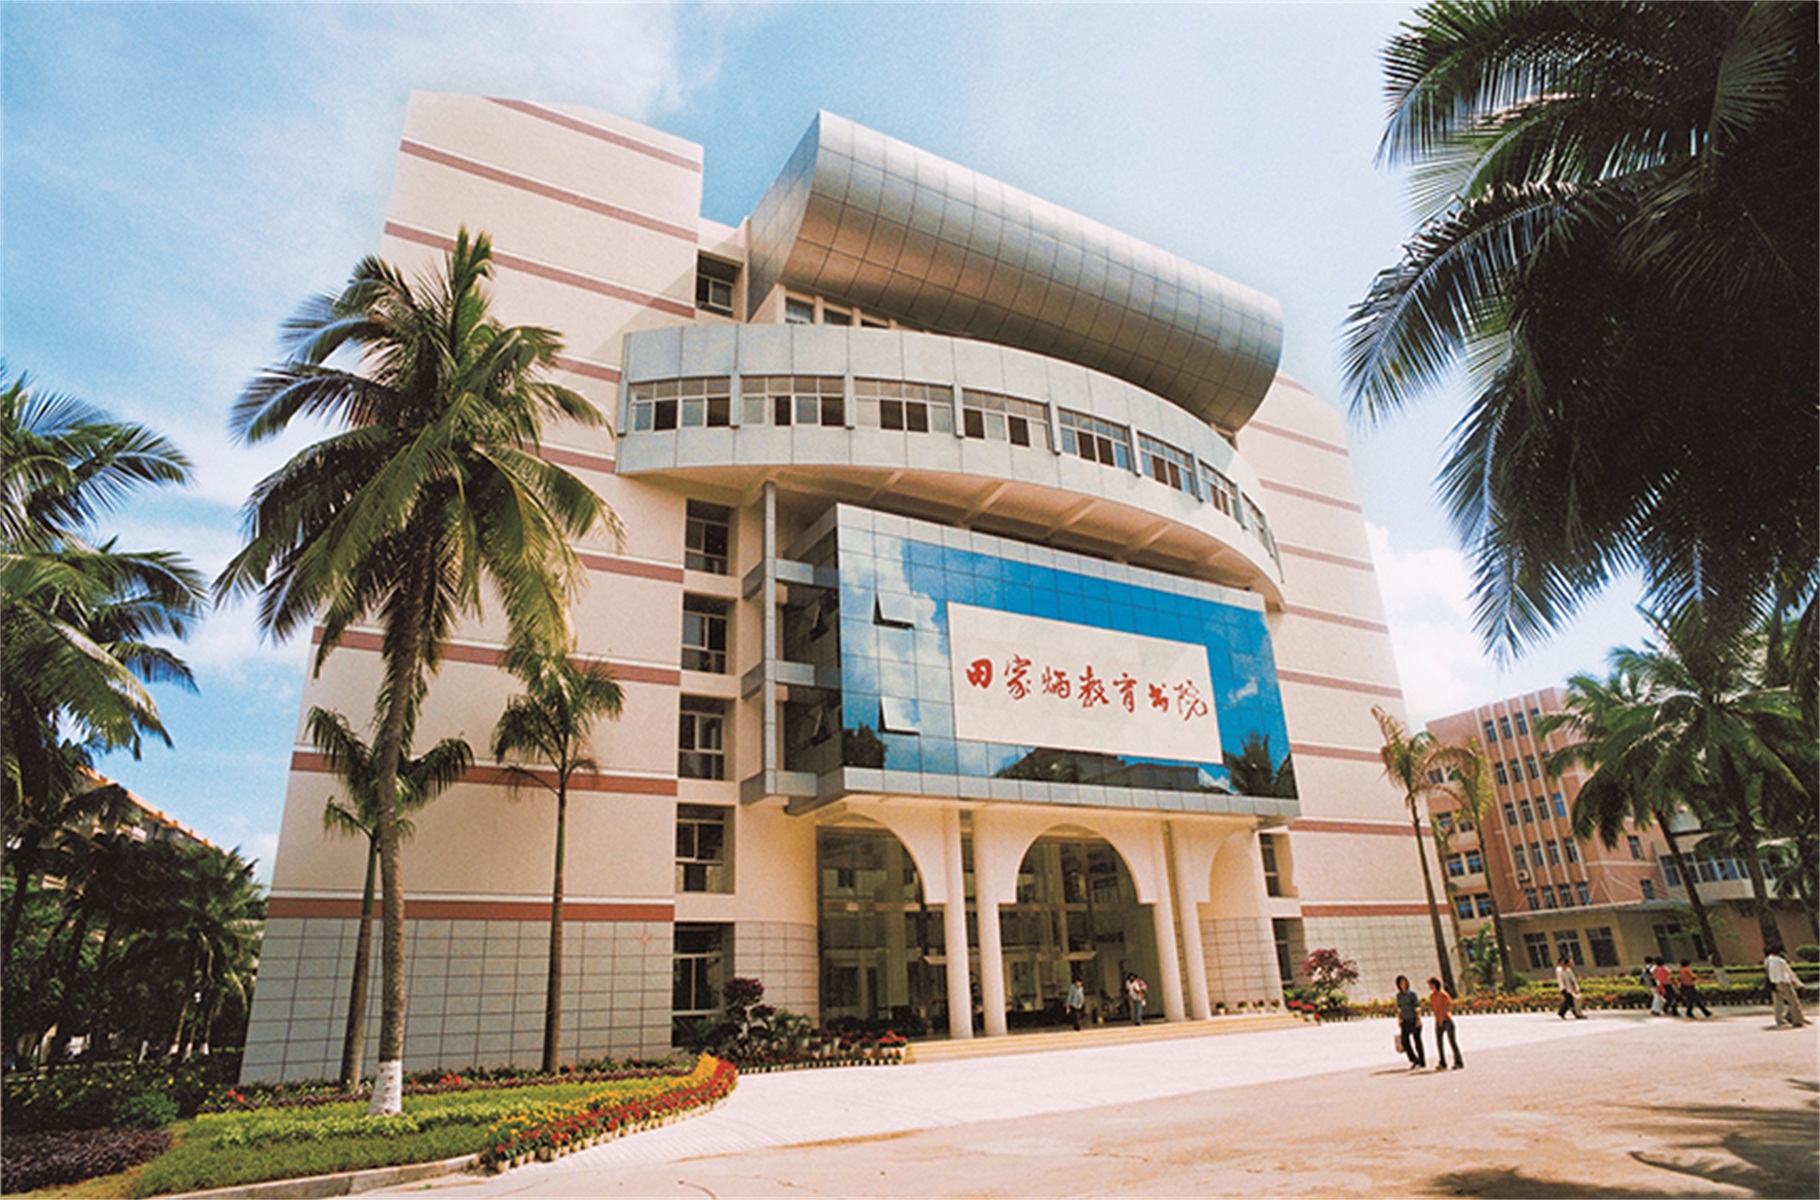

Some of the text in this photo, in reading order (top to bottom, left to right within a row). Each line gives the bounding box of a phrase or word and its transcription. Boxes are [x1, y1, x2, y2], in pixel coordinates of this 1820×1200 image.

[965, 653, 1208, 721] 田家炳教育书院
